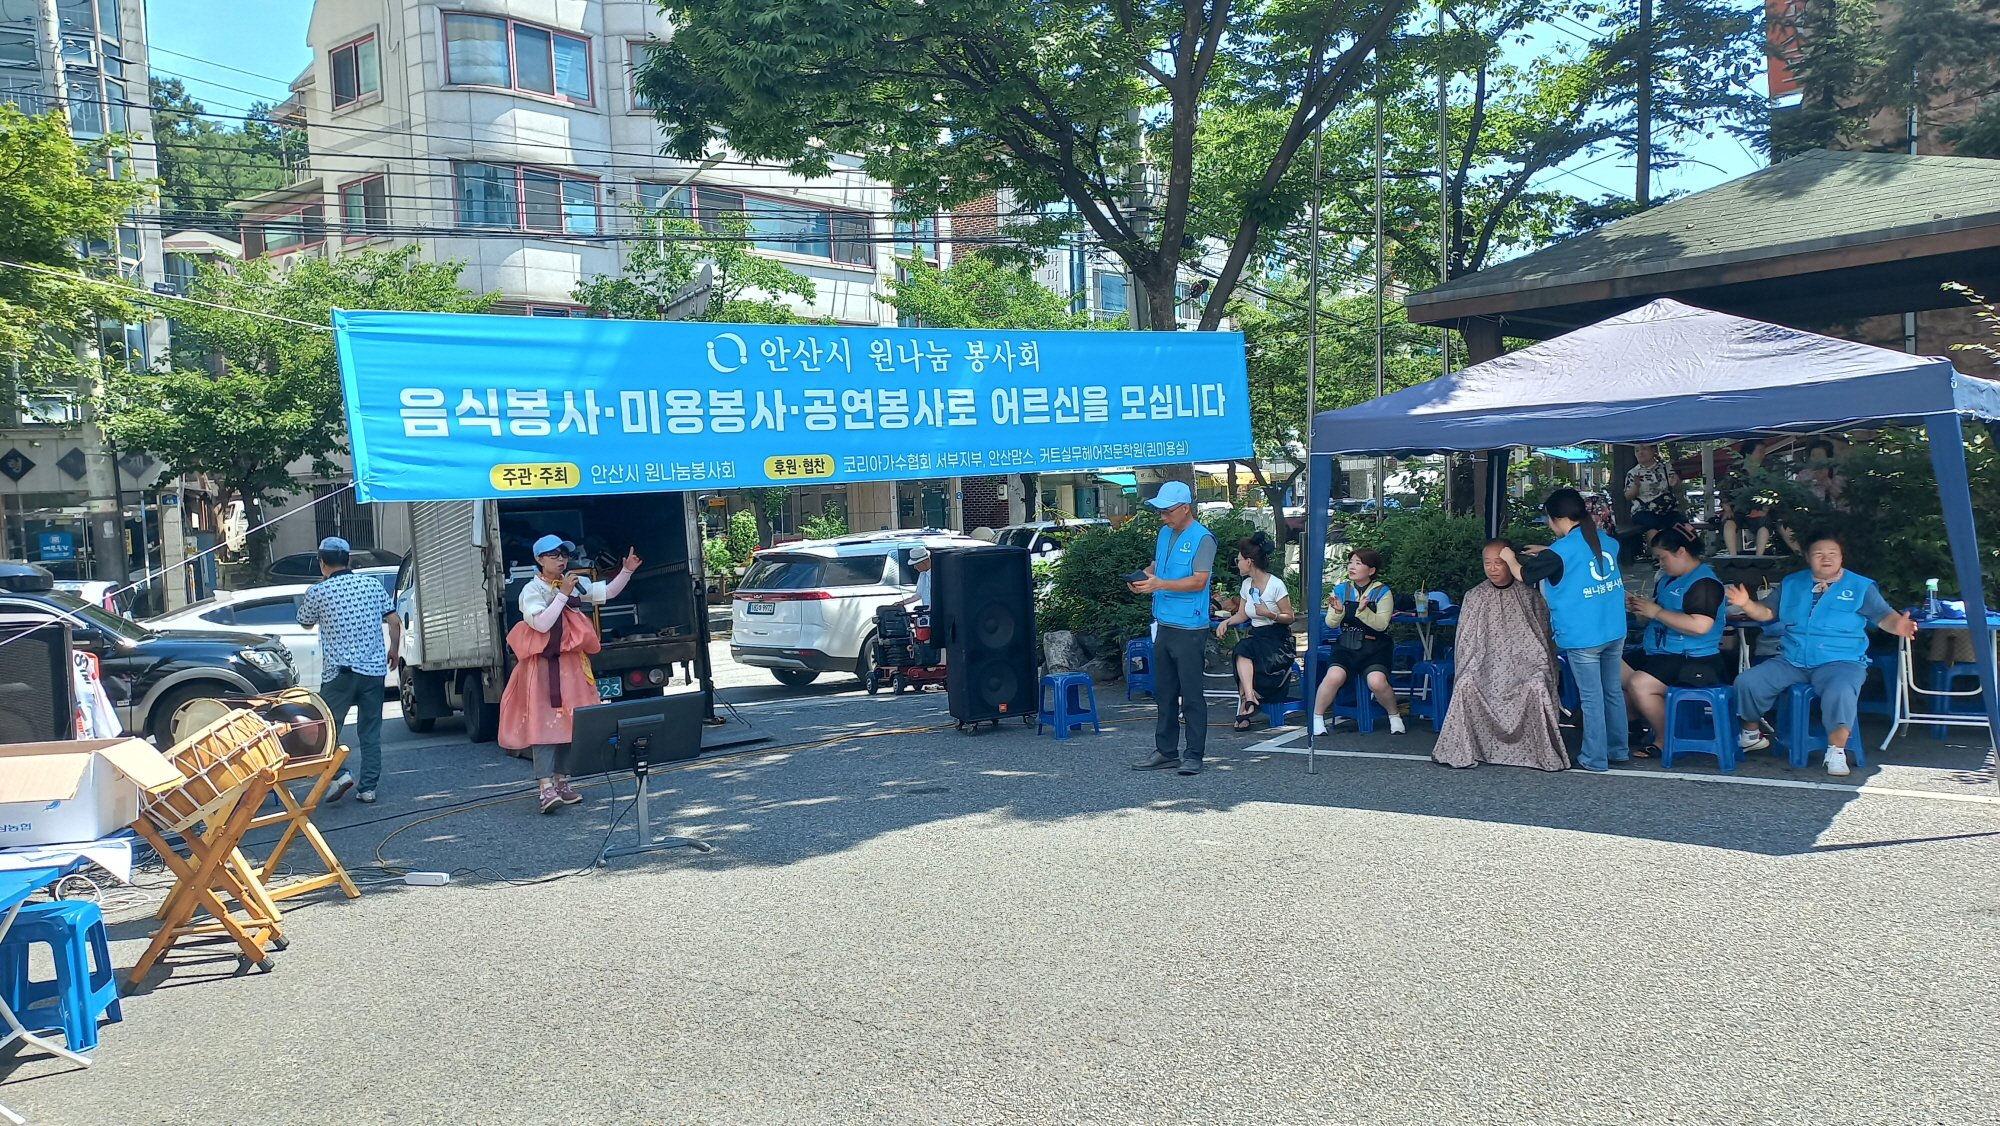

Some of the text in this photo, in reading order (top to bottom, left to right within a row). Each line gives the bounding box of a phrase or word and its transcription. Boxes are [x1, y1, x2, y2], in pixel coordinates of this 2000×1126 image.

[760, 336, 1041, 374] 안산시 원나눔 봉사회
[991, 385, 1109, 425] 어르신을
[1121, 382, 1226, 420] 모십니다
[590, 460, 737, 484] 안산시 원나눔봉사회
[774, 456, 826, 477] 후원·협찬
[843, 452, 932, 473] 코리아가수협회
[935, 451, 986, 469] 서부지부,
[988, 449, 1037, 466] 안산맘스,
[501, 465, 570, 488] 주관·주최
[1582, 578, 1624, 598] 원나눔봉사
